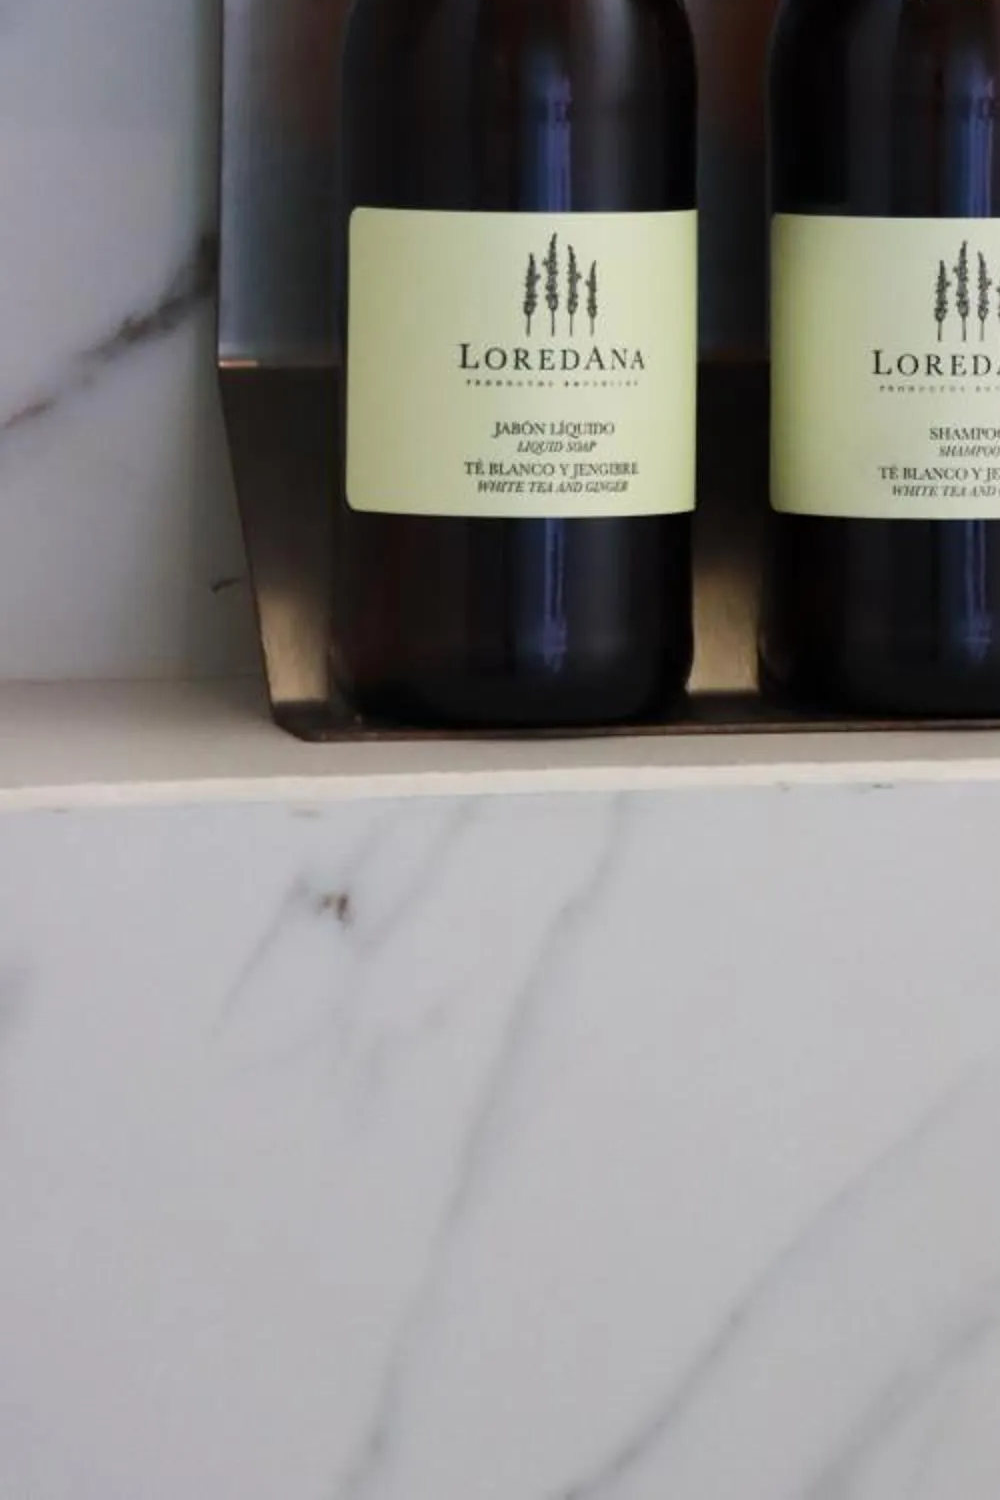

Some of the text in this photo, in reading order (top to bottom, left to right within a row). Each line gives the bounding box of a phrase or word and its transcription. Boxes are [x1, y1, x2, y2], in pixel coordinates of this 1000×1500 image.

[458, 343, 645, 370] LOREDANA
[491, 419, 616, 439] JABÓN LÍQUIDO
[938, 444, 1000, 457] SHAMPOO
[464, 458, 639, 478] TÉ BLANCO Y JENGIBRE
[878, 464, 899, 480] TÉ
[903, 467, 969, 481] BLANCO
[971, 467, 982, 480] Y
[477, 480, 524, 493] WHITE
[529, 481, 554, 493] TEA
[554, 481, 583, 493] AND
[891, 484, 938, 497] WHITE
